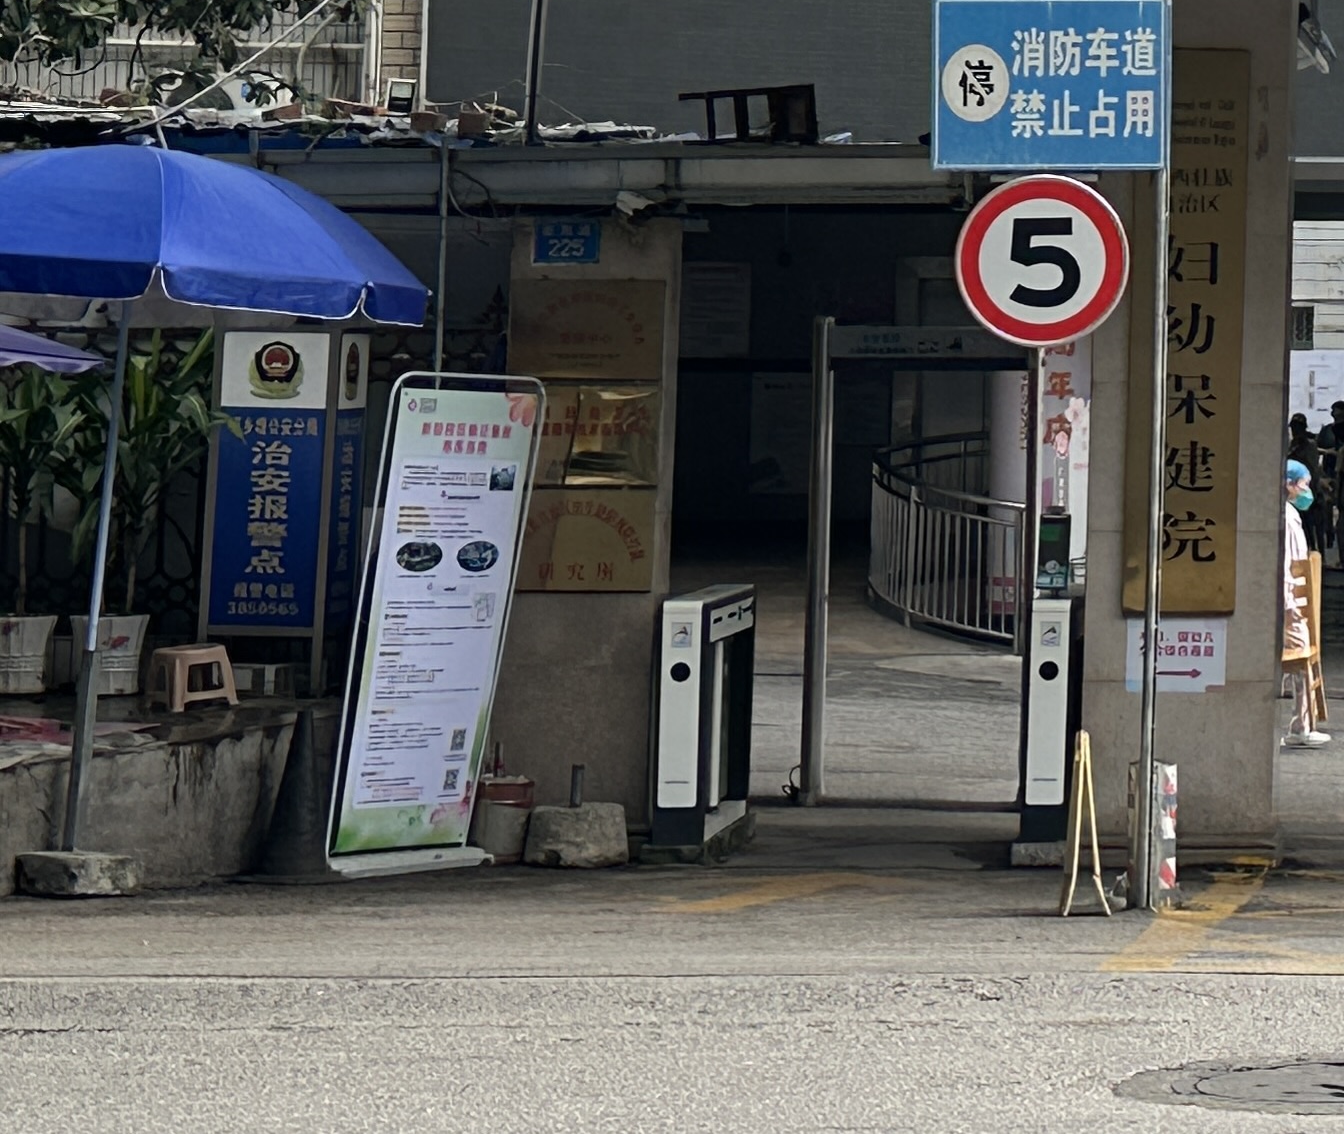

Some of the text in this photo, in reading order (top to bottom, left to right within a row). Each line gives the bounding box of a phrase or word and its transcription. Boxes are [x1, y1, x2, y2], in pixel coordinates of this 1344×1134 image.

[1010, 27, 1157, 77] 消防车道
[958, 59, 995, 107] 停
[1010, 89, 1156, 138] 禁止占用
[1009, 218, 1082, 307] 5
[245, 440, 292, 575] 治安报警点
